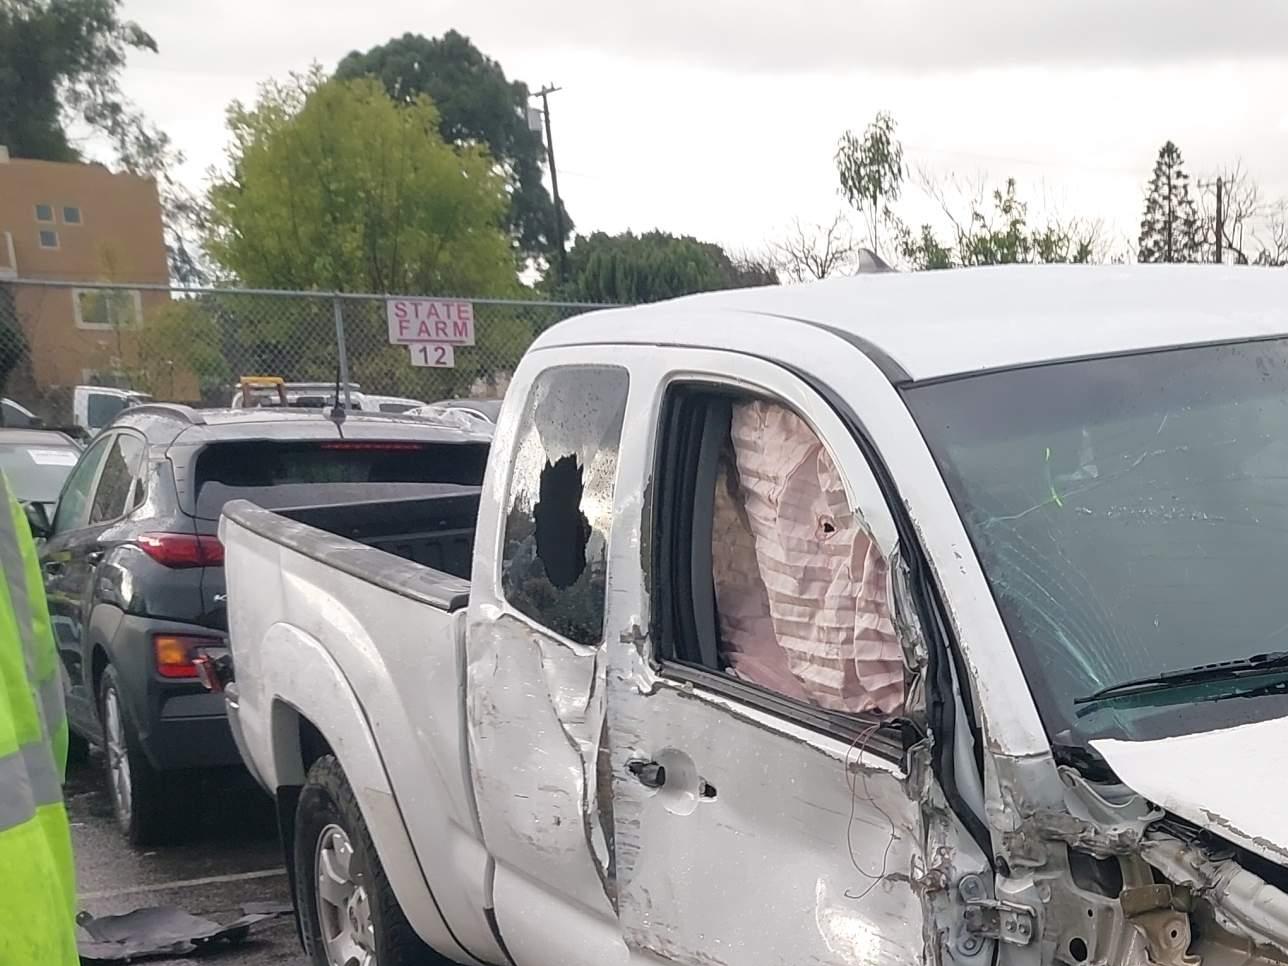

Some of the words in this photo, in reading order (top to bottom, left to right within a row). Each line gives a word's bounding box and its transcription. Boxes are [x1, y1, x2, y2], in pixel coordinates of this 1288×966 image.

[394, 301, 470, 320] STATE
[399, 320, 469, 338] FARM
[418, 346, 447, 366] 12
